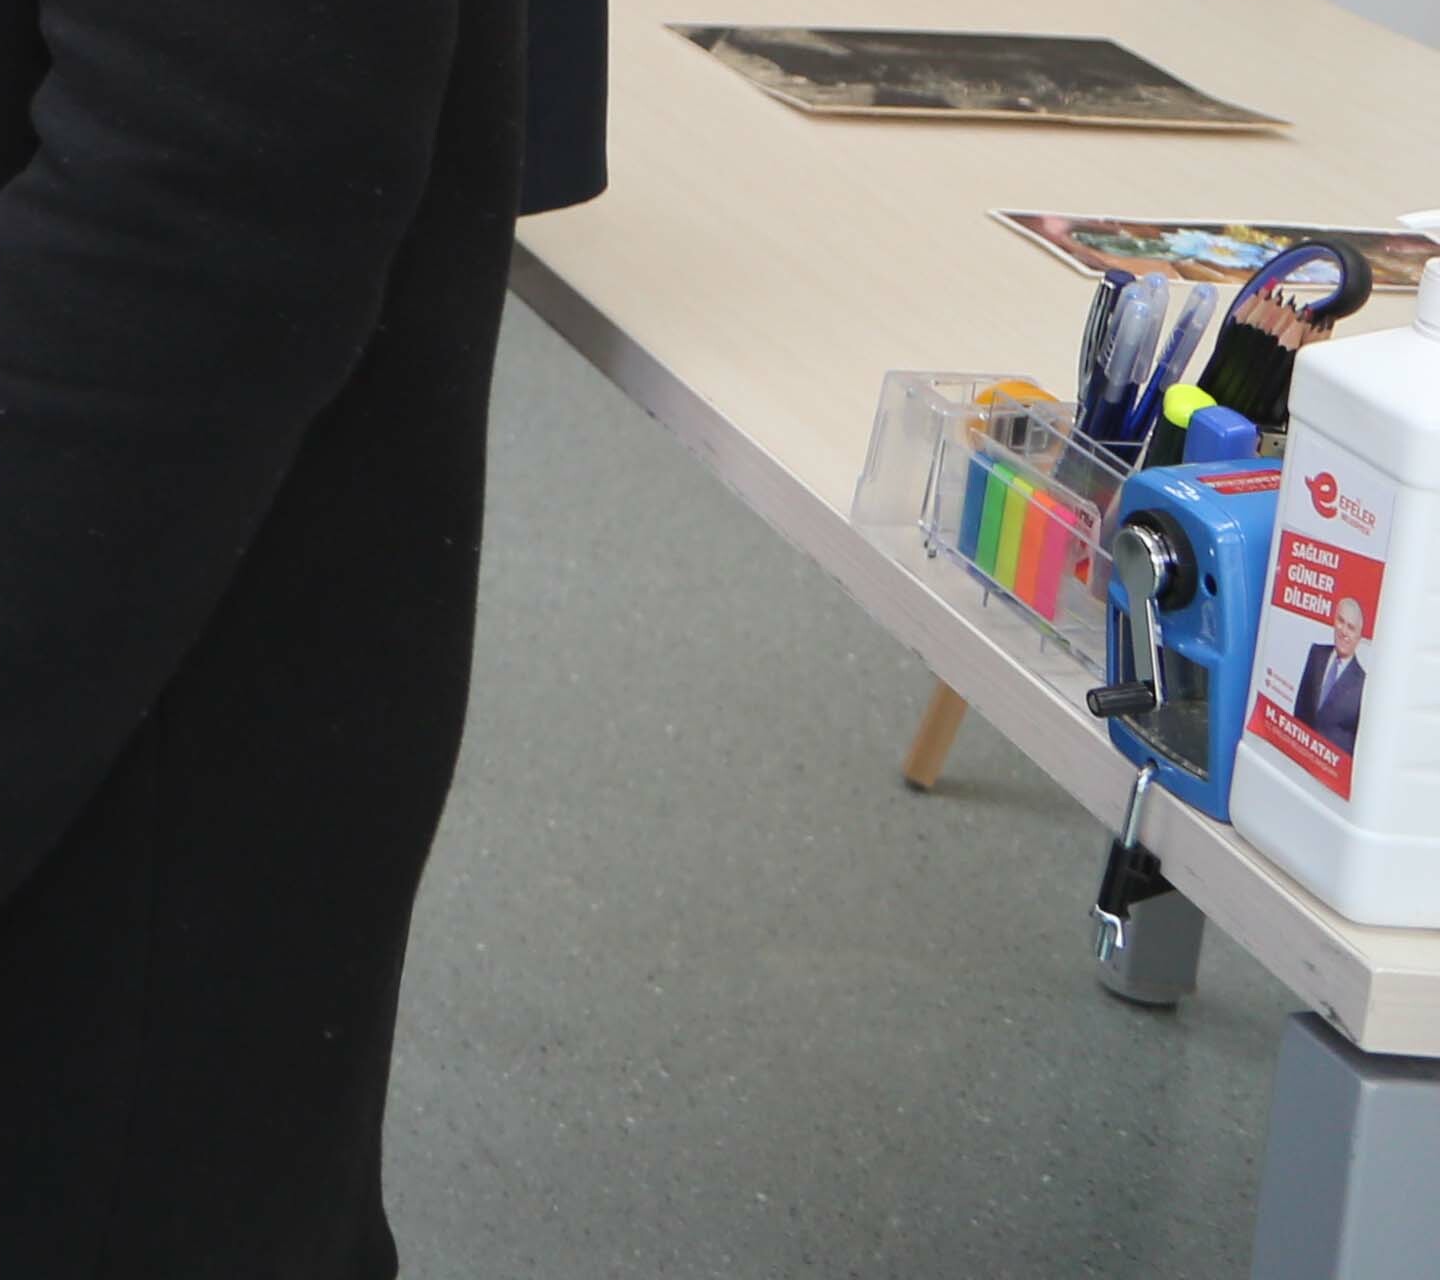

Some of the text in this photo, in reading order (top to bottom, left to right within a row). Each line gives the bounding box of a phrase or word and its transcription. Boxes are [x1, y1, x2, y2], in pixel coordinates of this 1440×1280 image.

[1291, 542, 1340, 569] SAĞLIKLI
[1287, 564, 1335, 593] GÜNLER
[1283, 587, 1332, 616] DİLERİM
[1310, 739, 1341, 767] ATAY
